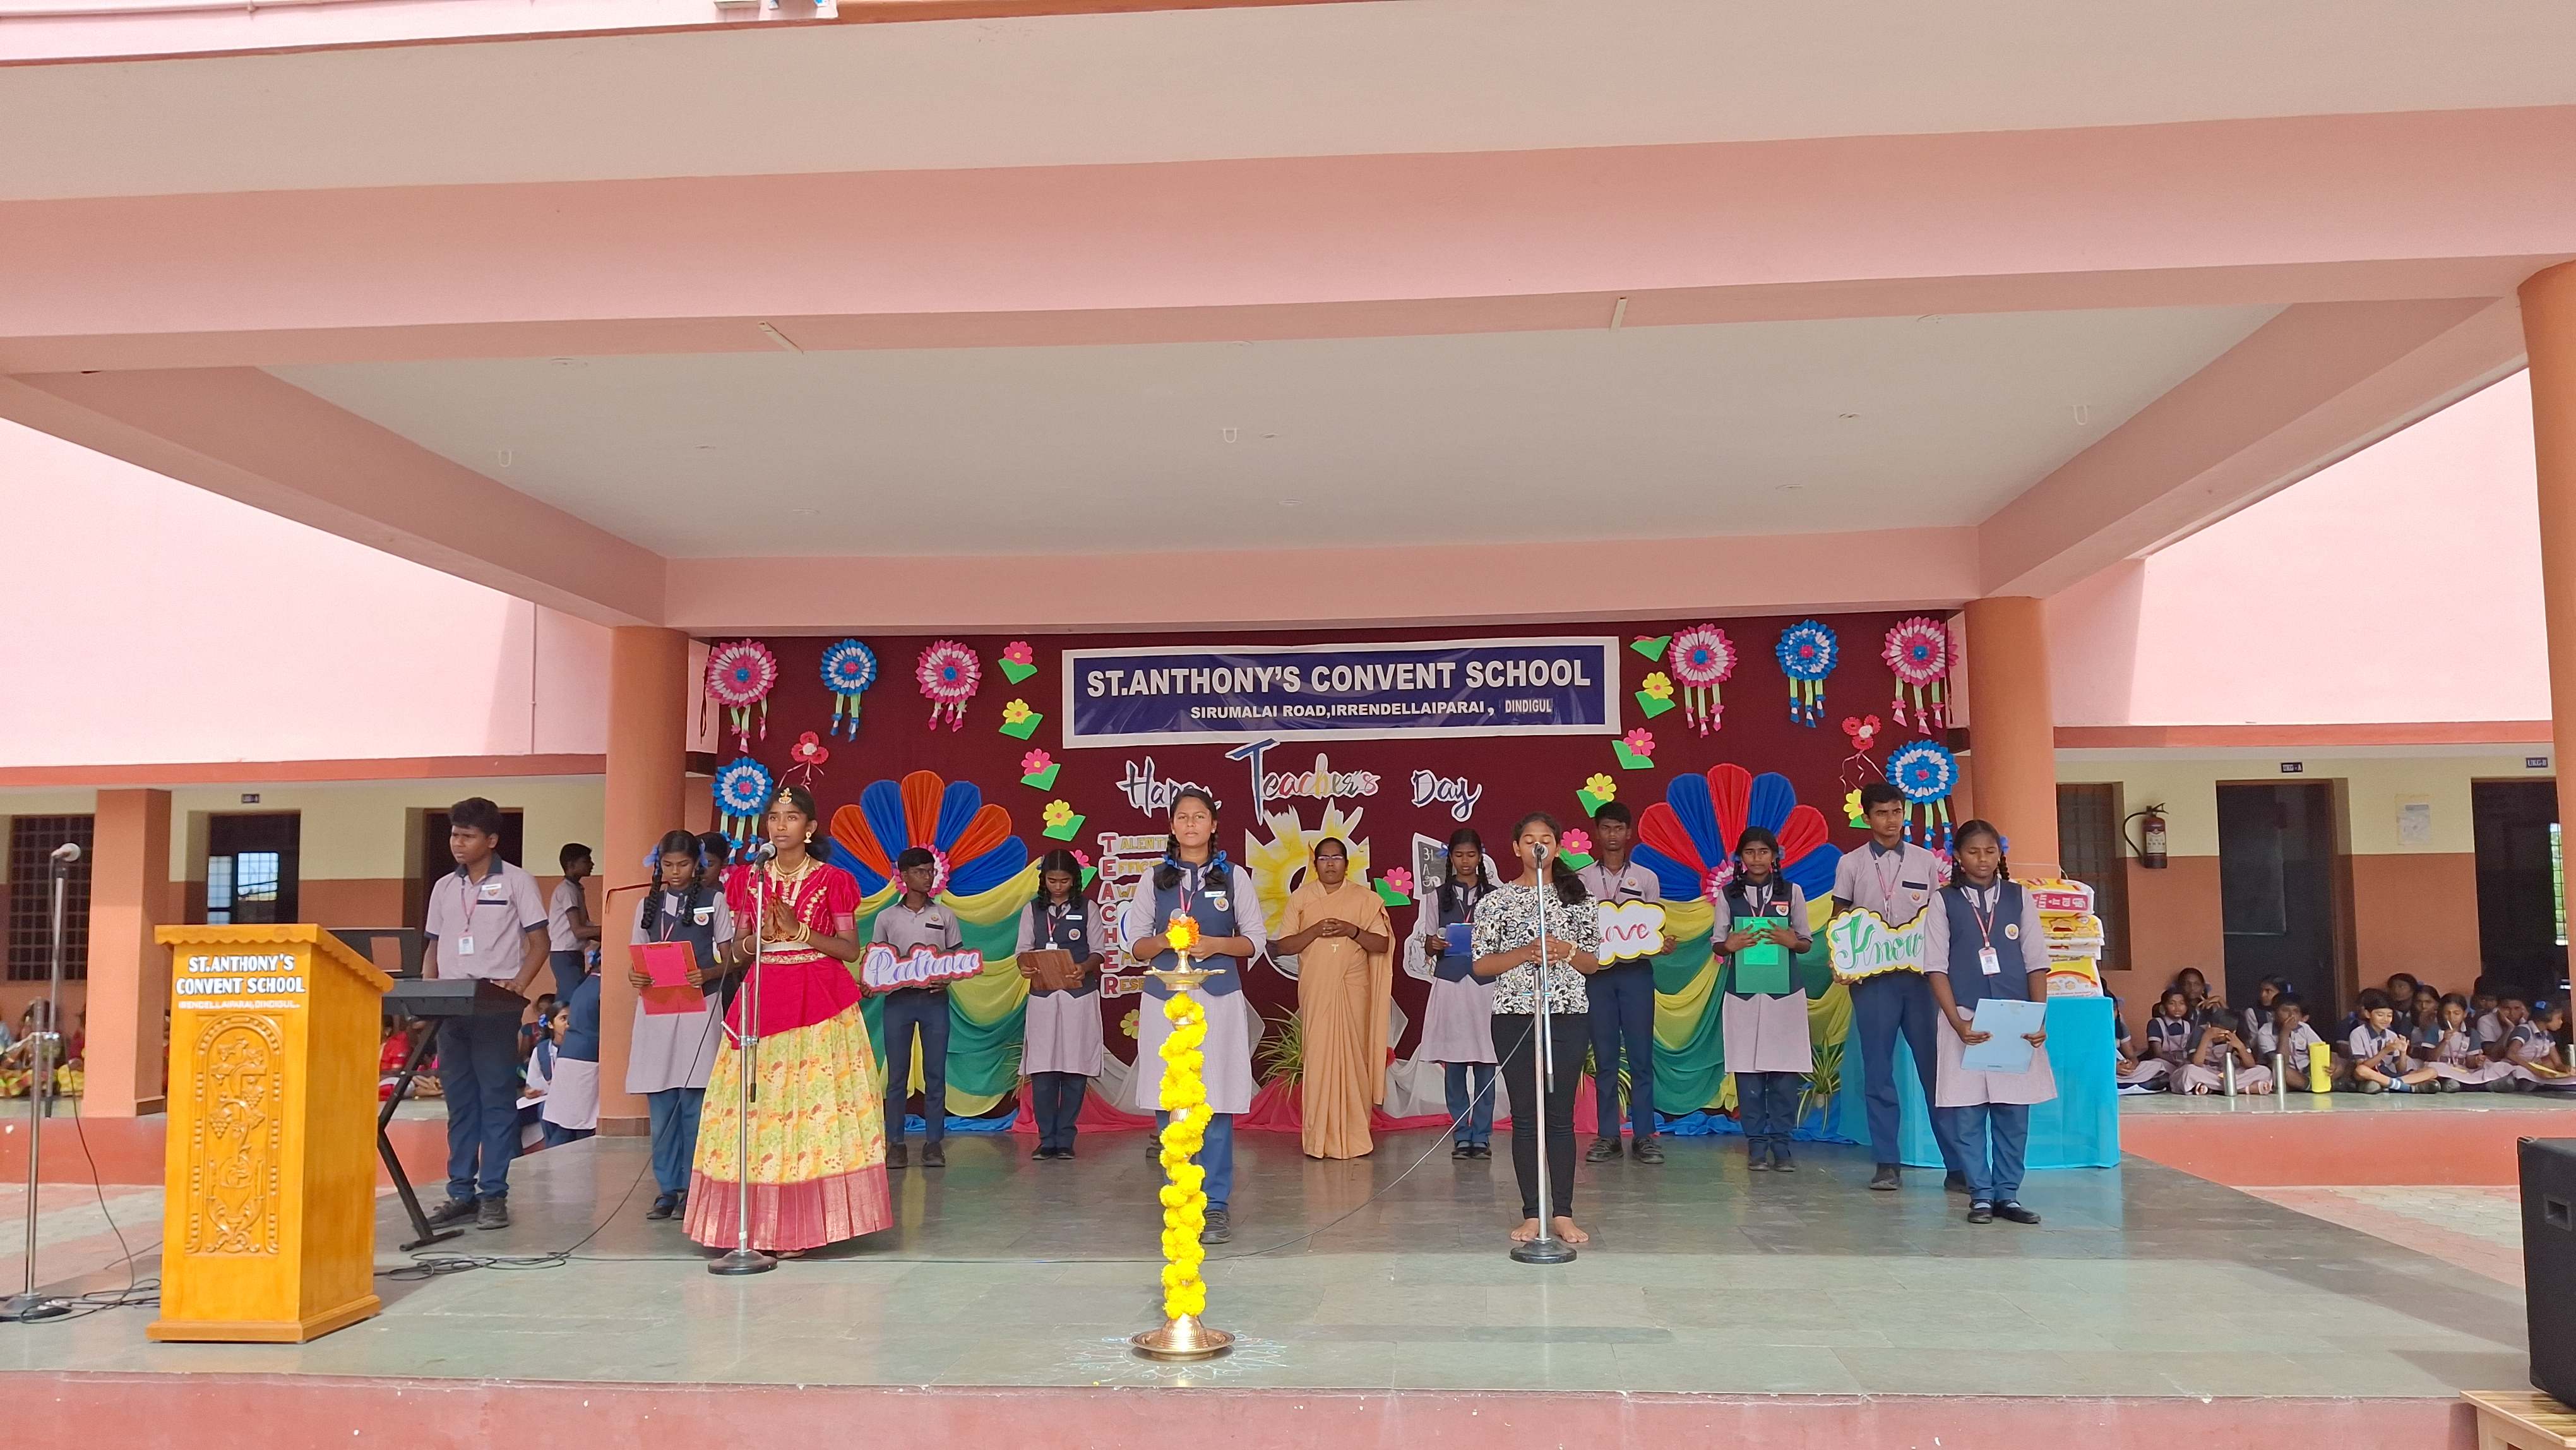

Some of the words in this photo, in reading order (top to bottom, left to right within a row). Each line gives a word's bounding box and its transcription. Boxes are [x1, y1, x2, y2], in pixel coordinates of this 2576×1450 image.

[1087, 666, 1301, 697] ST.ANTHONY'S
[1311, 662, 1456, 692] CONVENT
[1465, 659, 1591, 688] SCHOOL
[1191, 706, 1277, 719] SIRUMALAI
[1505, 699, 1552, 713] DINDIGUL
[1121, 758, 1219, 817] Hap
[1413, 772, 1481, 818] Day
[1422, 863, 1430, 875] A
[1599, 923, 1650, 943] ove
[188, 953, 295, 973] ST.ANTHONY'S
[869, 949, 978, 986] Patience
[176, 978, 243, 995] CONVENT
[247, 976, 306, 994] SCHOOL
